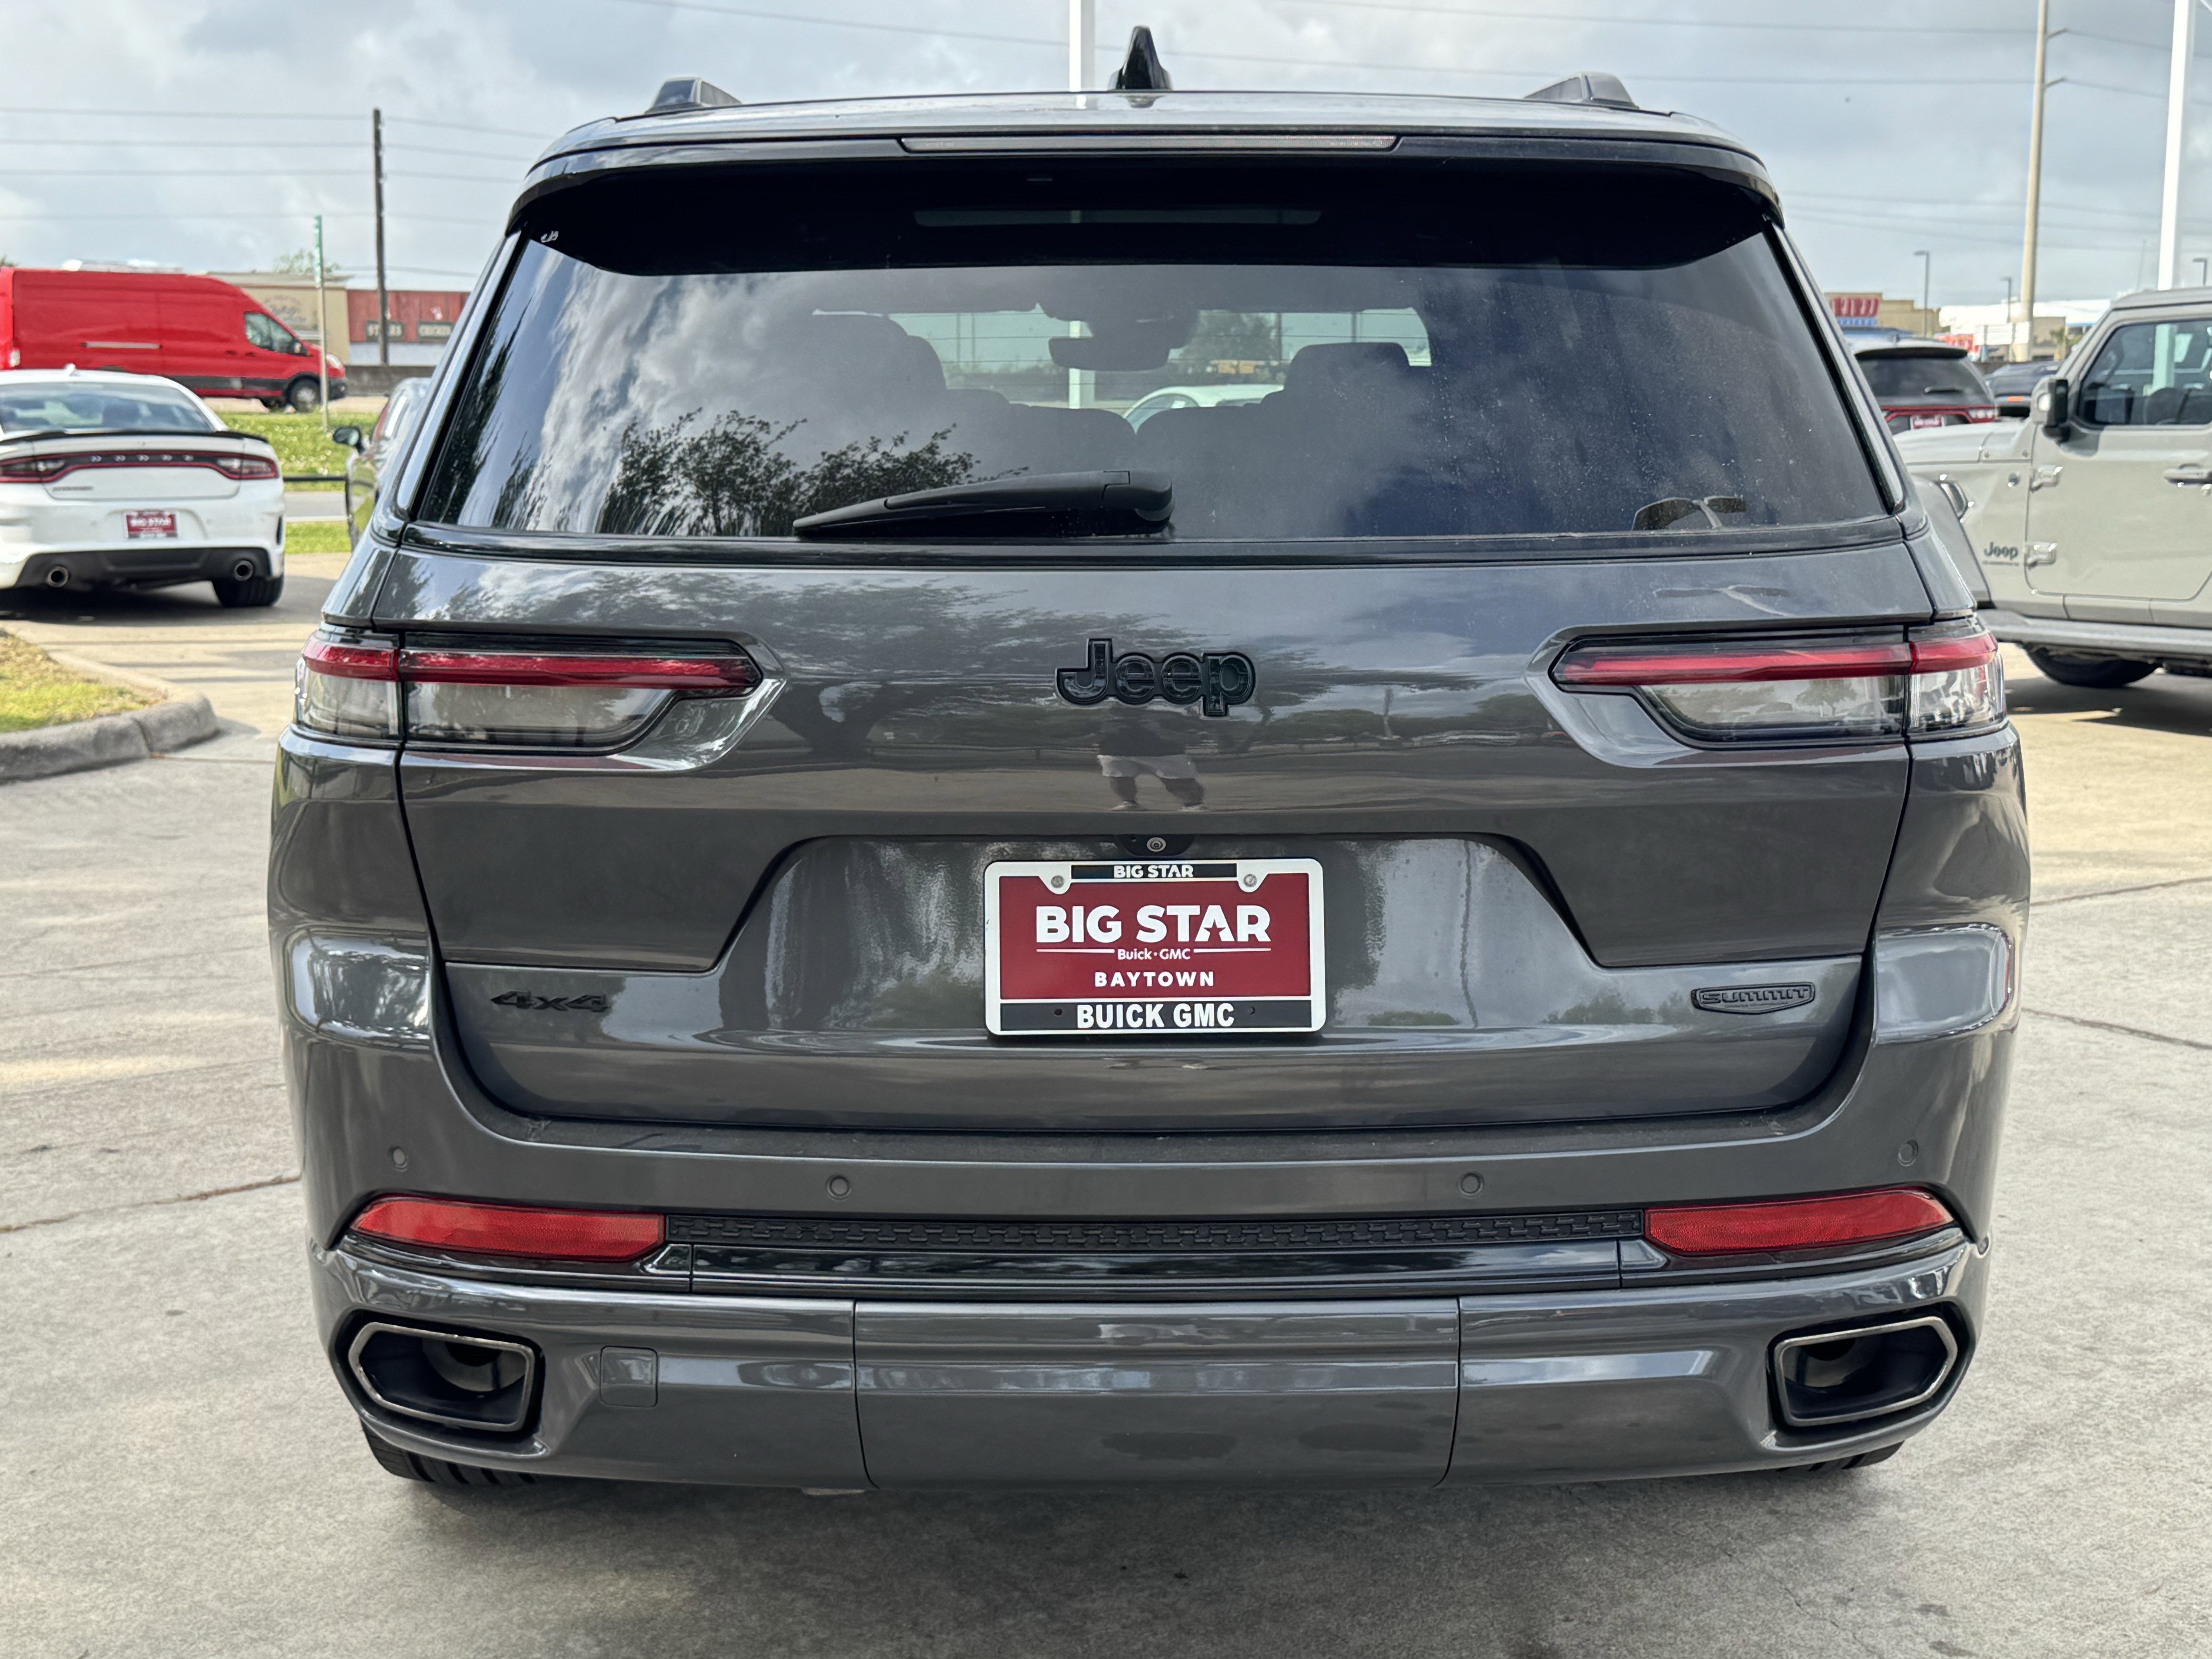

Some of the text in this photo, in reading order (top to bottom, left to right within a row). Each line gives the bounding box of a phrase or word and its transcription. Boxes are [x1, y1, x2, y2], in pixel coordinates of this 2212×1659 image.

[1984, 542, 2018, 560] Jeep
[1055, 638, 1255, 717] Jeep
[1113, 864, 1194, 878] BIG STAR
[1036, 905, 1271, 943] BIG STAR
[1094, 971, 1214, 987] BAYTOWN
[1077, 1003, 1235, 1029] BUICK GMC
